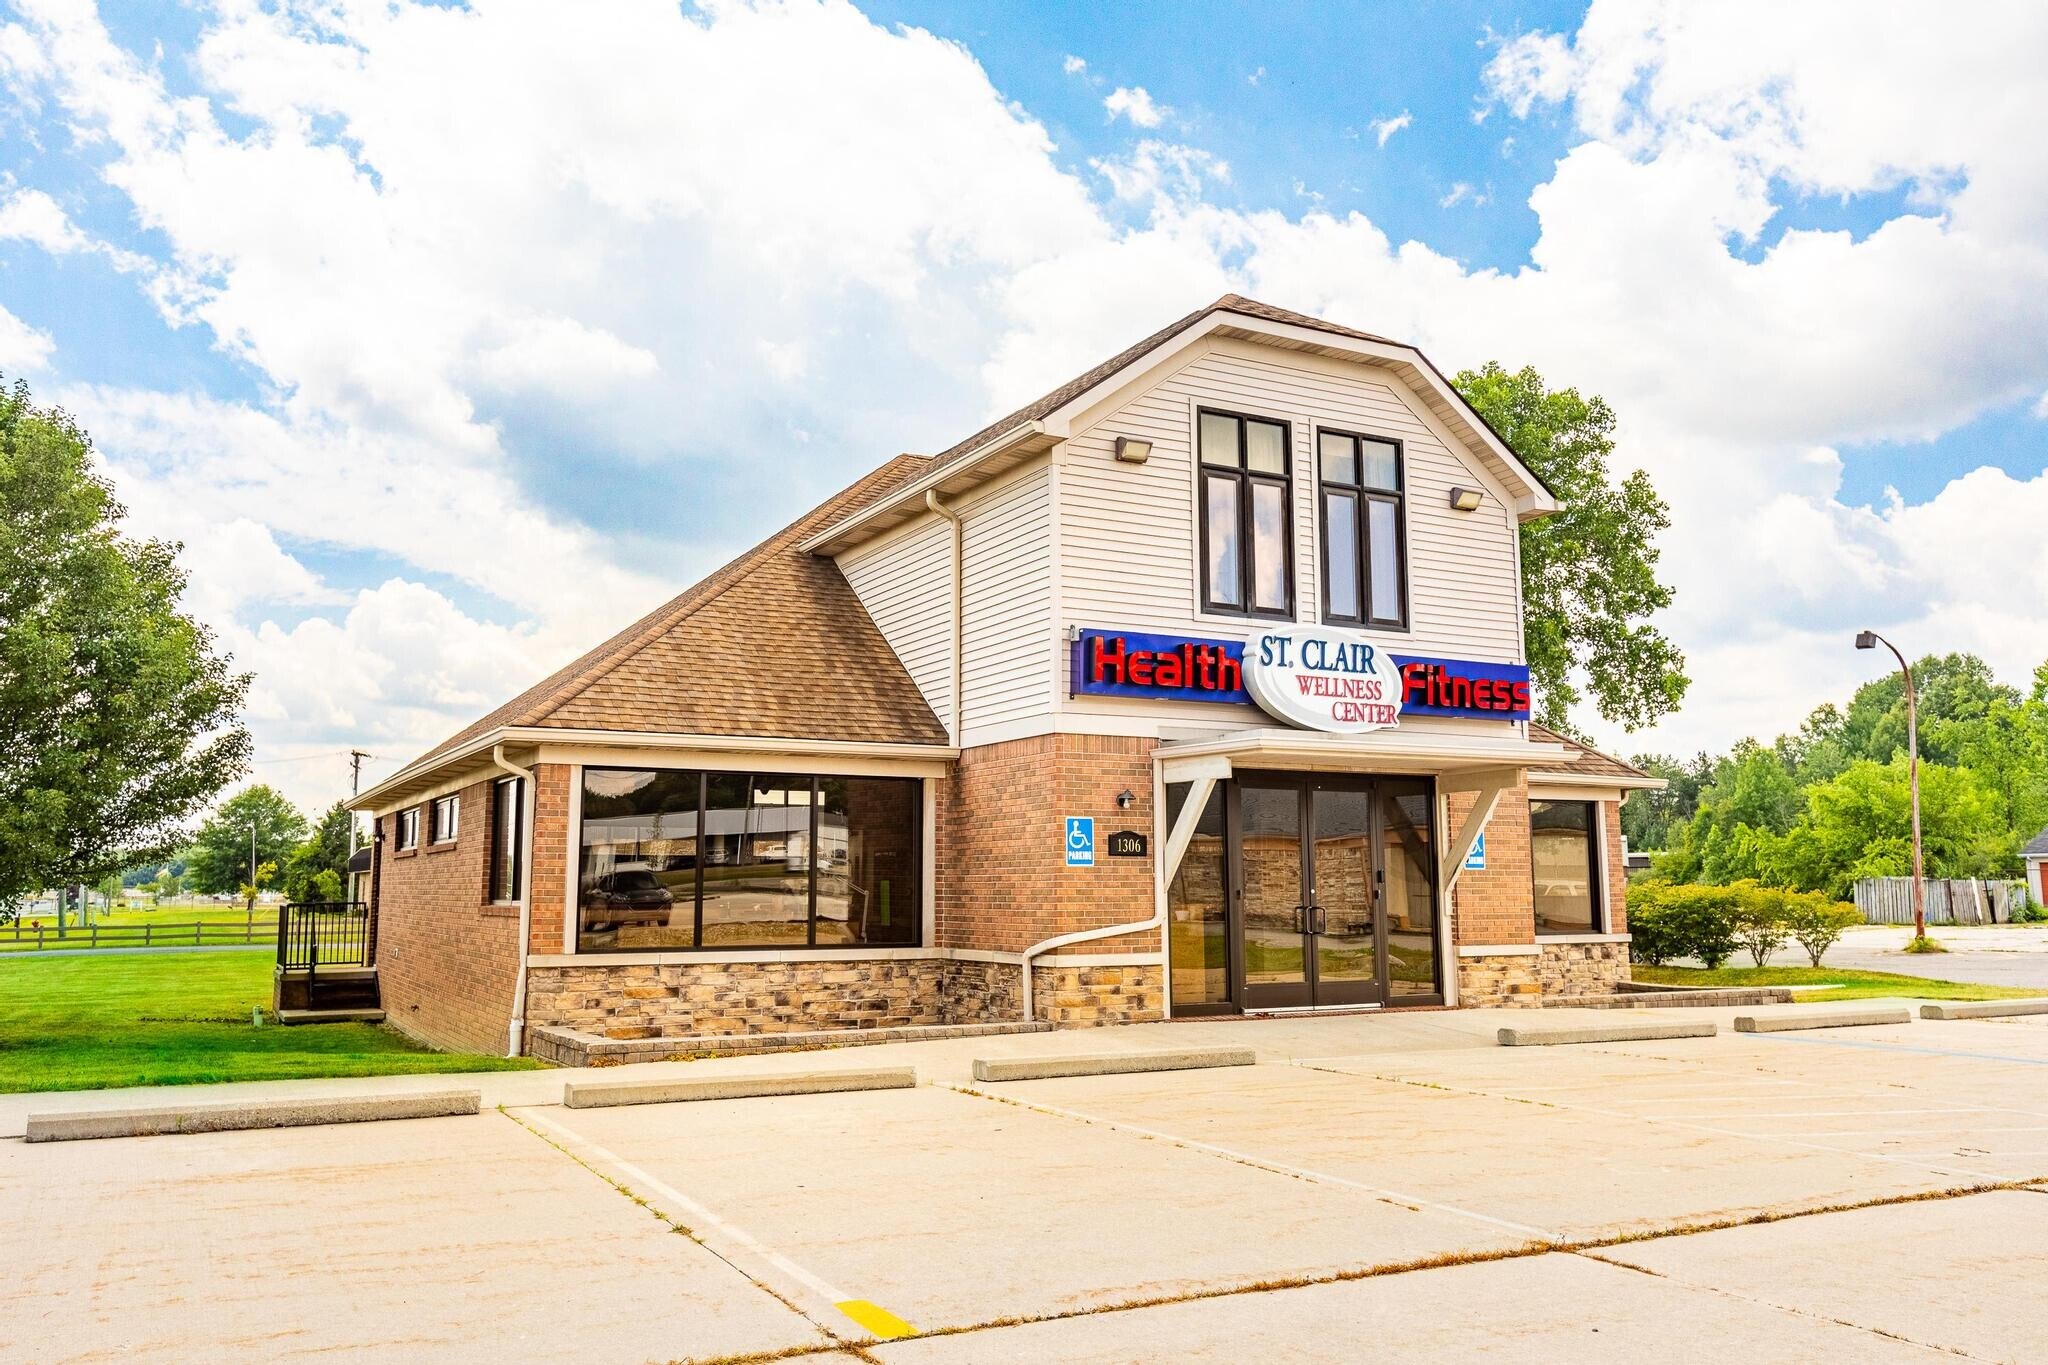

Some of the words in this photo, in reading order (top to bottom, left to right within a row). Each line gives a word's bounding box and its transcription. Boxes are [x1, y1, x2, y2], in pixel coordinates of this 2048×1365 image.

[1094, 635, 1242, 691] Health
[1260, 635, 1294, 668] ST.
[1301, 639, 1377, 674] CLAIR
[1296, 674, 1382, 700] WELLNESS
[1402, 662, 1530, 711] Fitness
[1332, 701, 1398, 724] CENTER
[1068, 850, 1092, 861] PARKING
[1117, 838, 1141, 853] 1306
